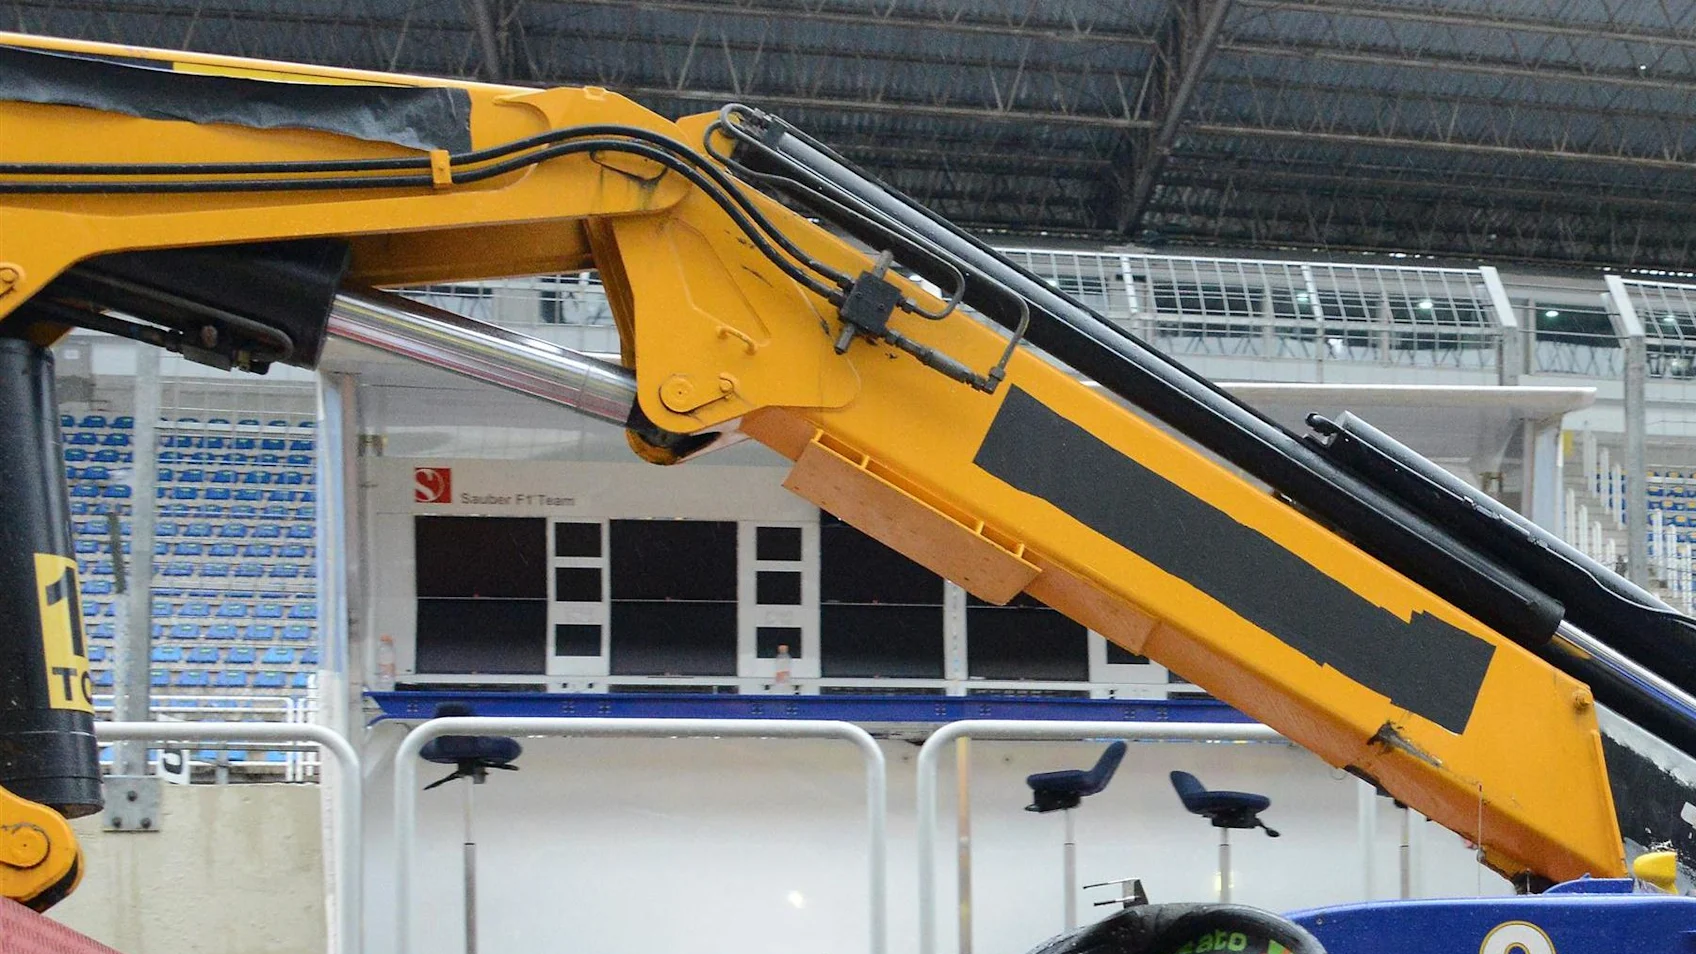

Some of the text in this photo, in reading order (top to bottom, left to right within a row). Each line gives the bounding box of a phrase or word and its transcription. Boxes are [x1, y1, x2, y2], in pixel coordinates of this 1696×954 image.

[460, 492, 575, 506] Sauber F1 Team
